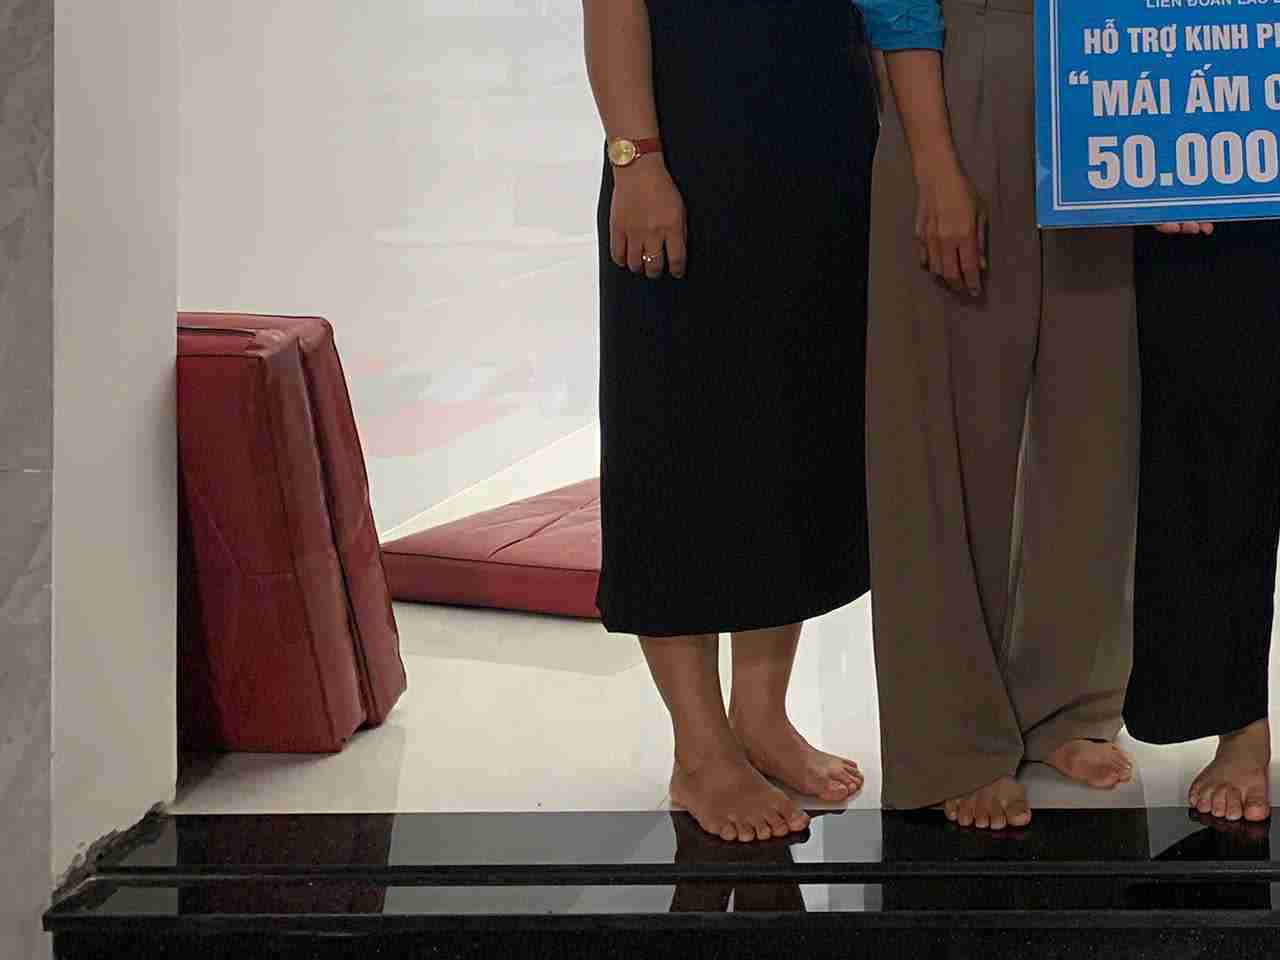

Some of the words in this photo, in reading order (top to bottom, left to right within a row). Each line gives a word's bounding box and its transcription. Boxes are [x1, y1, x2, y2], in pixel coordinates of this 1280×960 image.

[1083, 18, 1120, 56] HỖ
[1127, 23, 1178, 58] TRỢ
[1185, 23, 1249, 52] KINH
[1184, 63, 1251, 113] ẤM
